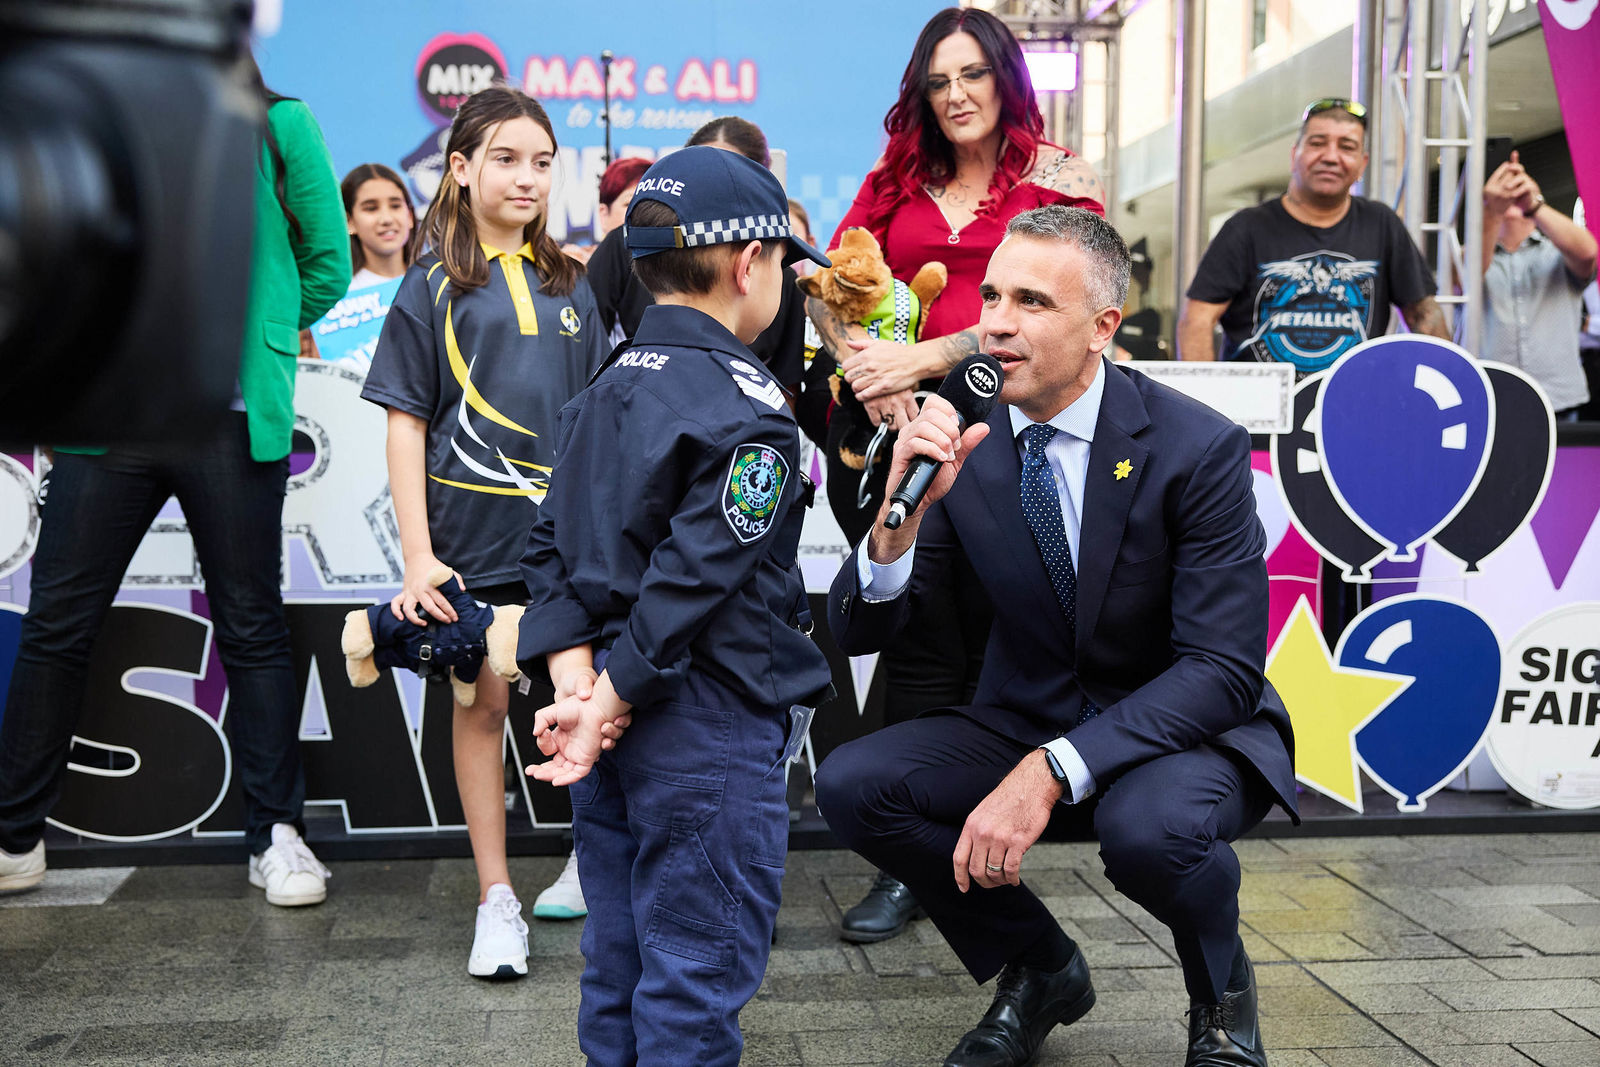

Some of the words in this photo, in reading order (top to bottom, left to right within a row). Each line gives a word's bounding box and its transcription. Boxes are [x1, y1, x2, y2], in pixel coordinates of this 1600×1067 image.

[427, 64, 495, 95] MIX
[525, 57, 636, 99] MAX
[645, 65, 668, 95] &
[676, 59, 757, 101] ALI
[636, 177, 685, 196] POLICE
[614, 351, 670, 370] POLICE
[971, 368, 995, 390] MIX
[727, 504, 766, 534] POLICE
